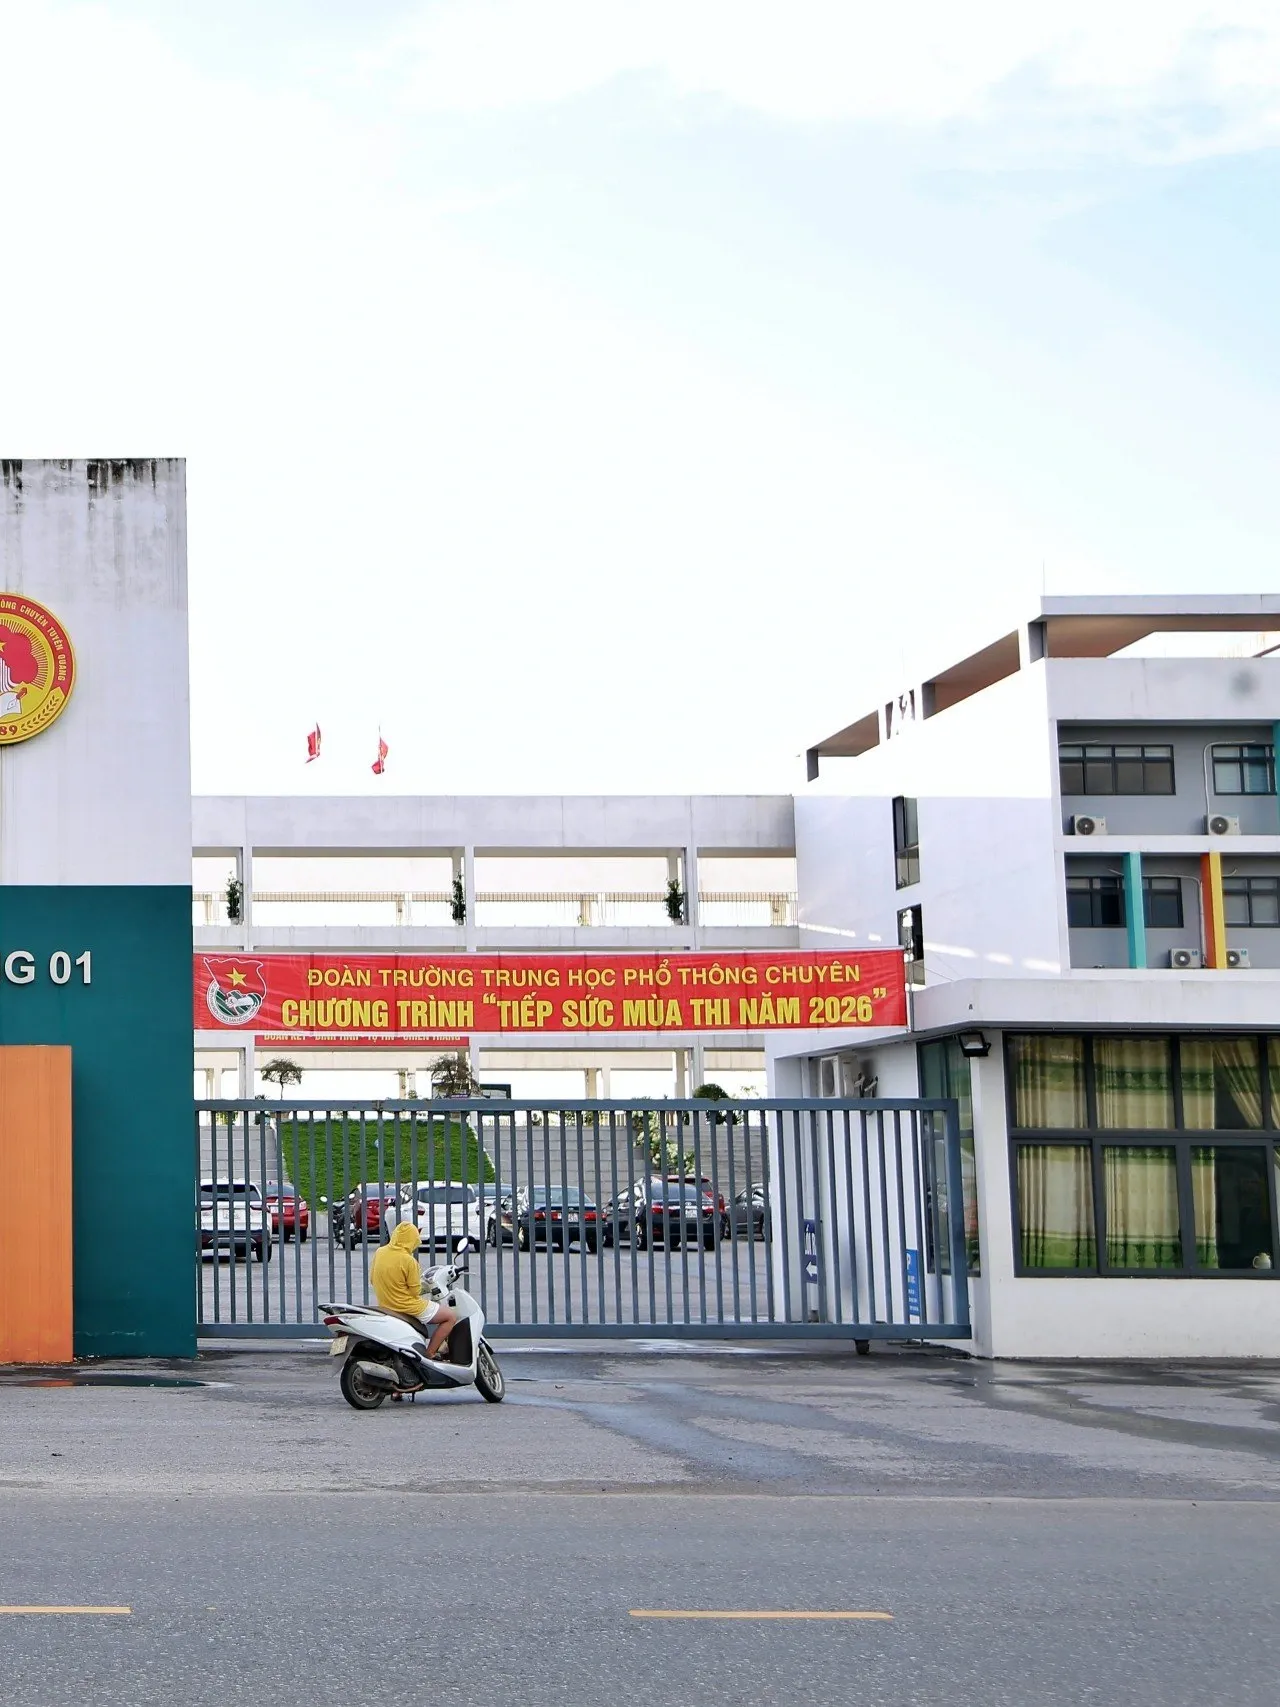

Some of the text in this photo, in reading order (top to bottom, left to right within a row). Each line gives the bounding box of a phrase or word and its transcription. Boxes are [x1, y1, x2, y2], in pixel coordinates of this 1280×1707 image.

[20, 604, 49, 627] CHUYÊN
[46, 626, 64, 651] TUYÊN
[57, 654, 67, 681] QUANG
[49, 950, 92, 985] 01
[307, 959, 861, 990] ĐOÀN TRƯỜNG TRUNG HỌC PHỔ THÔNG CHUYÊN
[281, 997, 389, 1028] CHƯƠNG
[396, 994, 475, 1027] TRÌNH
[561, 994, 614, 1028] SỨC
[622, 994, 685, 1027] MÙA
[689, 998, 732, 1026] THI
[739, 992, 801, 1026] NĂM
